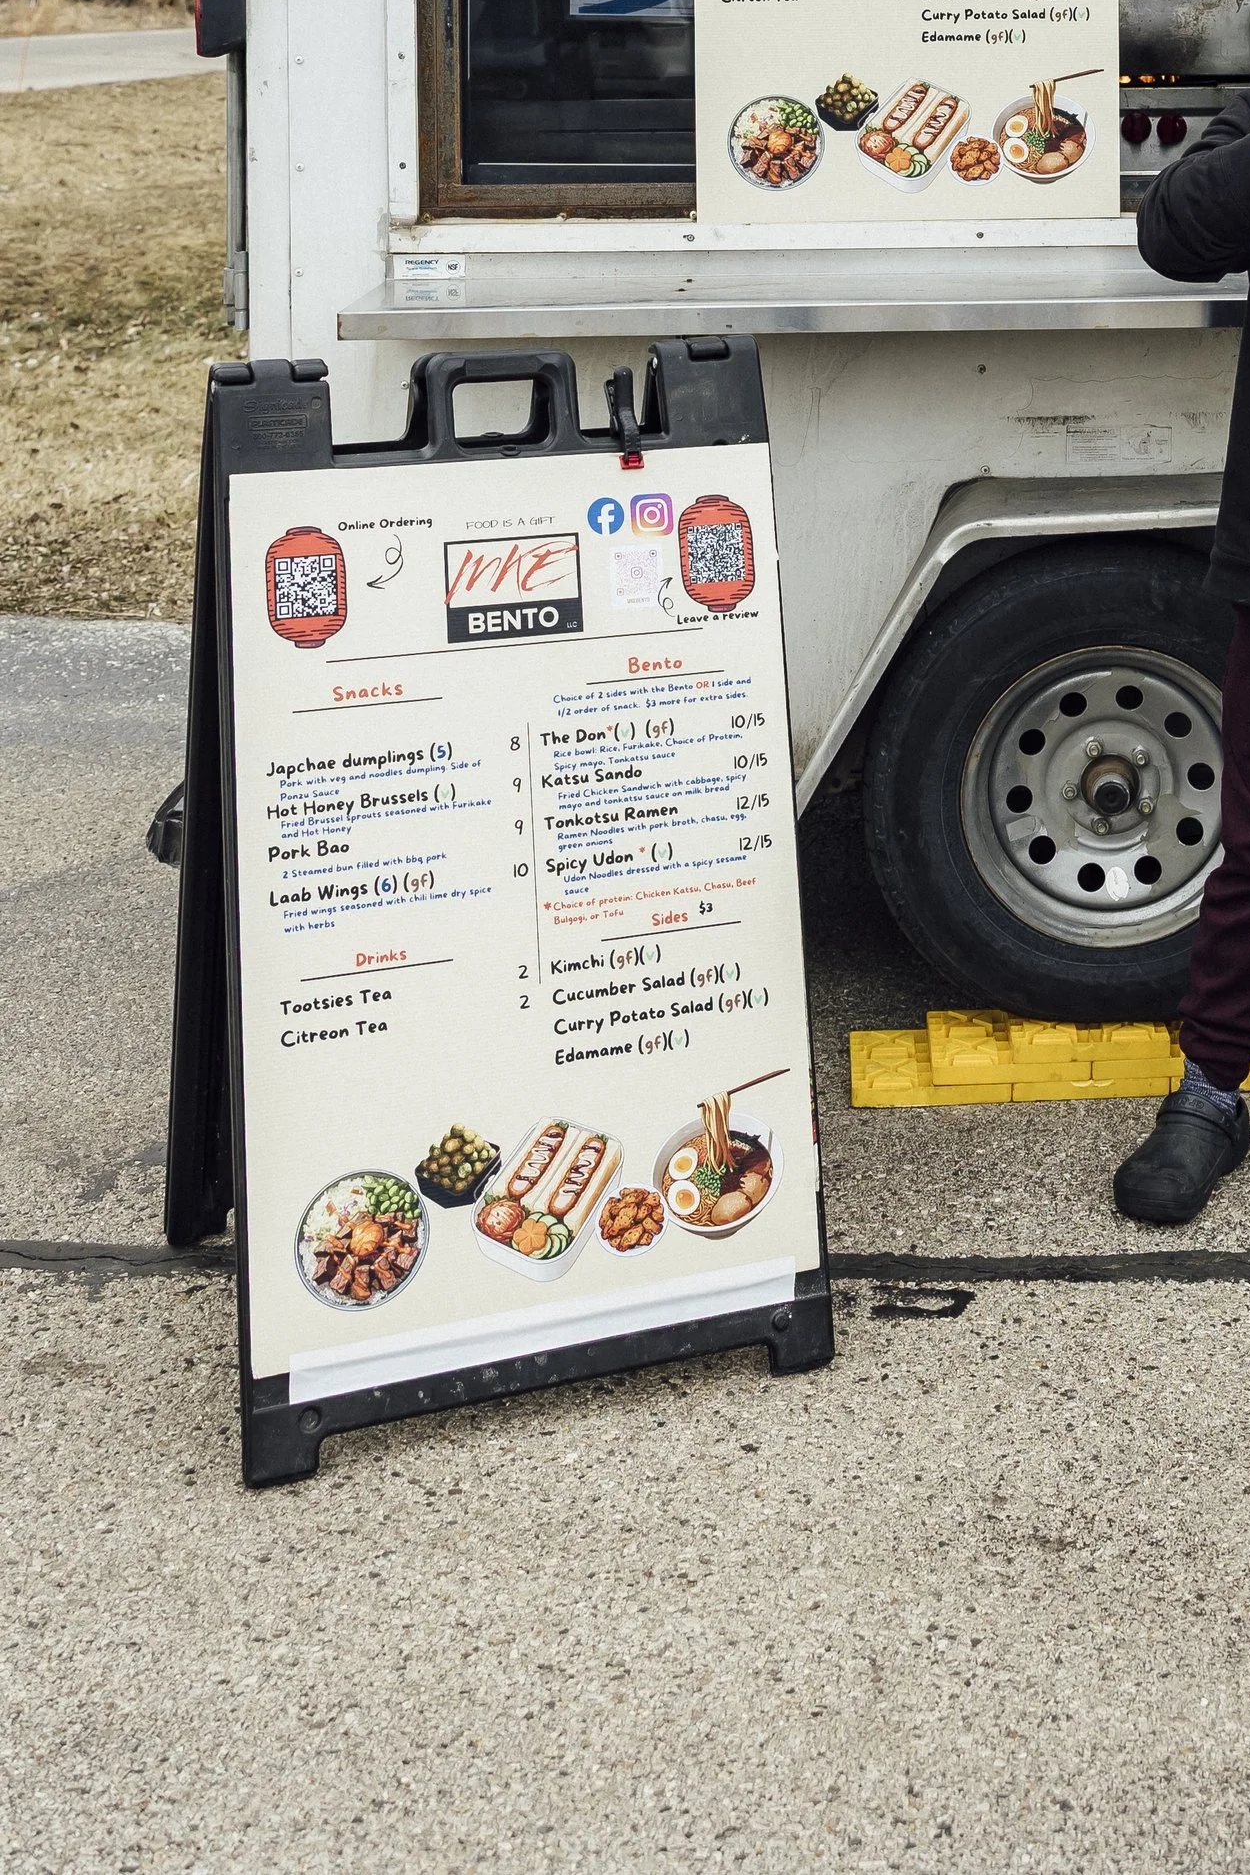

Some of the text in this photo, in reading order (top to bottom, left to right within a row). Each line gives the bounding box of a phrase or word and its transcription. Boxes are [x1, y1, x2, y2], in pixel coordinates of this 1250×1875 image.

[921, 30, 981, 44] Edamame
[338, 517, 432, 531] Online Ordering
[466, 520, 498, 529] FOOD
[503, 519, 512, 527] IS
[530, 516, 555, 525] GIFT
[444, 541, 578, 605] MKE
[468, 606, 559, 634] BENTO
[677, 614, 709, 625] Leave
[723, 610, 759, 620] review
[628, 657, 682, 674] Bento
[331, 682, 403, 702] Snacks
[552, 695, 583, 703] Choice
[585, 692, 594, 700] of
[598, 691, 603, 700] 2
[606, 689, 628, 698] sides
[630, 687, 648, 695] with
[668, 684, 693, 692] Bento
[696, 681, 709, 689] OR
[716, 678, 733, 688] side
[736, 677, 752, 685] and
[558, 707, 571, 717] 1/2
[574, 706, 598, 714] order
[601, 704, 610, 712] of
[646, 698, 656, 709] $3
[540, 713, 766, 746] The 10/15
[266, 735, 520, 779] Japchae dumplings (5) 8
[542, 752, 768, 788] Katsu Sando 10/15
[266, 804, 298, 820] Hot
[303, 797, 355, 821] Honey
[360, 789, 428, 809] Brussels
[513, 777, 521, 793] 9
[544, 793, 769, 830] Tonkotsu Ramen 12/15
[268, 819, 523, 862] Pork Bao 9
[546, 833, 772, 876] Spicy Udon 12/15
[270, 863, 529, 907] Laab Wings (6) (gf) 10
[553, 901, 583, 911] Choice
[586, 898, 596, 906] of
[636, 890, 671, 900] Chicken
[736, 877, 756, 887] Beef
[652, 900, 713, 926] Sides $3
[355, 949, 407, 968] Drinks
[550, 954, 604, 975] Kimchi
[280, 965, 529, 1015] Tootsies Tea 2
[553, 981, 636, 1005] Cucumber
[642, 971, 686, 992] Salad
[281, 995, 530, 1048] Citreon Tea 2
[554, 1018, 604, 1035] Curry
[609, 1008, 665, 1026] Potato
[670, 996, 714, 1018] Salad
[555, 1043, 632, 1065] Edamame
